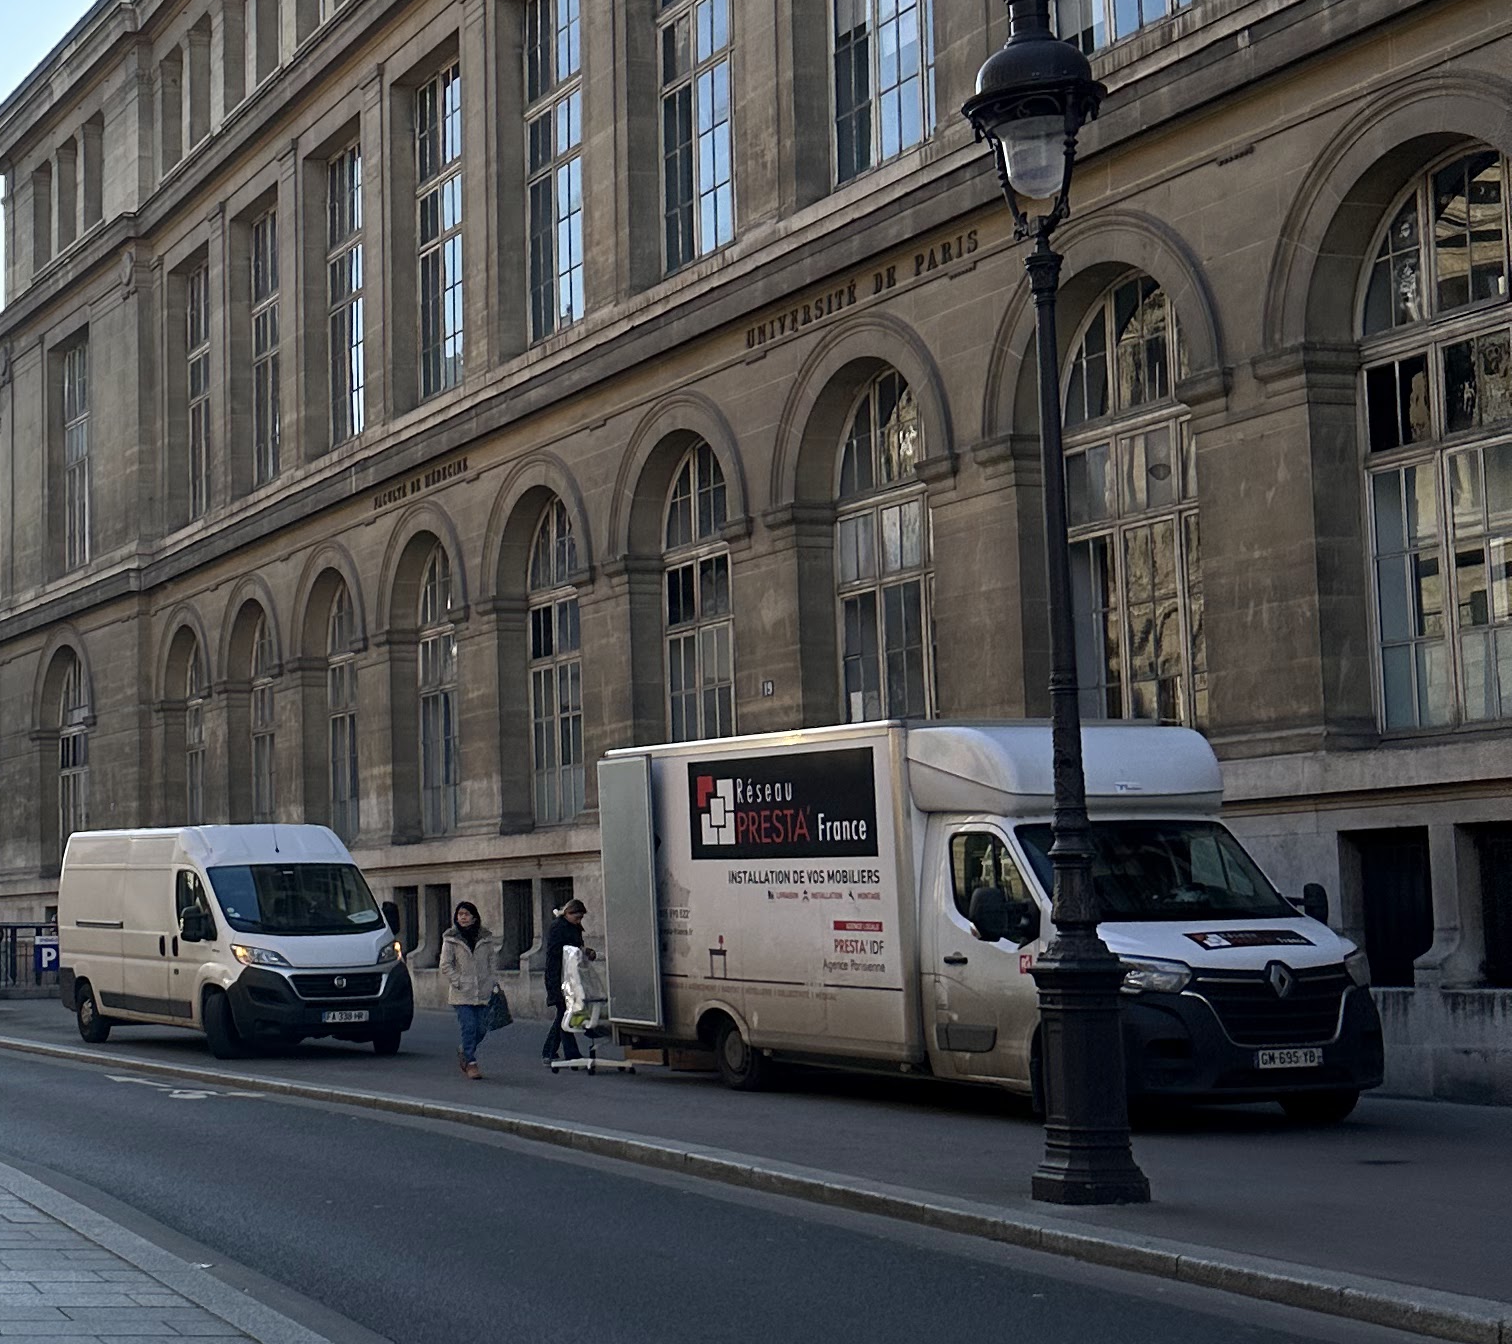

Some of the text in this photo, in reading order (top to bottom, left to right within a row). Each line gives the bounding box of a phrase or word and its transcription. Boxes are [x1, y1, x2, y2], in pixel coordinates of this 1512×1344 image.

[746, 229, 979, 349] UNIVERSITÉ DE PARIS
[411, 478, 421, 495] DE
[764, 681, 773, 696] 19
[736, 778, 793, 804] Réseau
[817, 812, 867, 841] France
[728, 869, 880, 884] INSTALLATION DE VOS MOBILIERS
[870, 940, 884, 955] IDF
[41, 947, 57, 967] P
[823, 958, 848, 973] Agence
